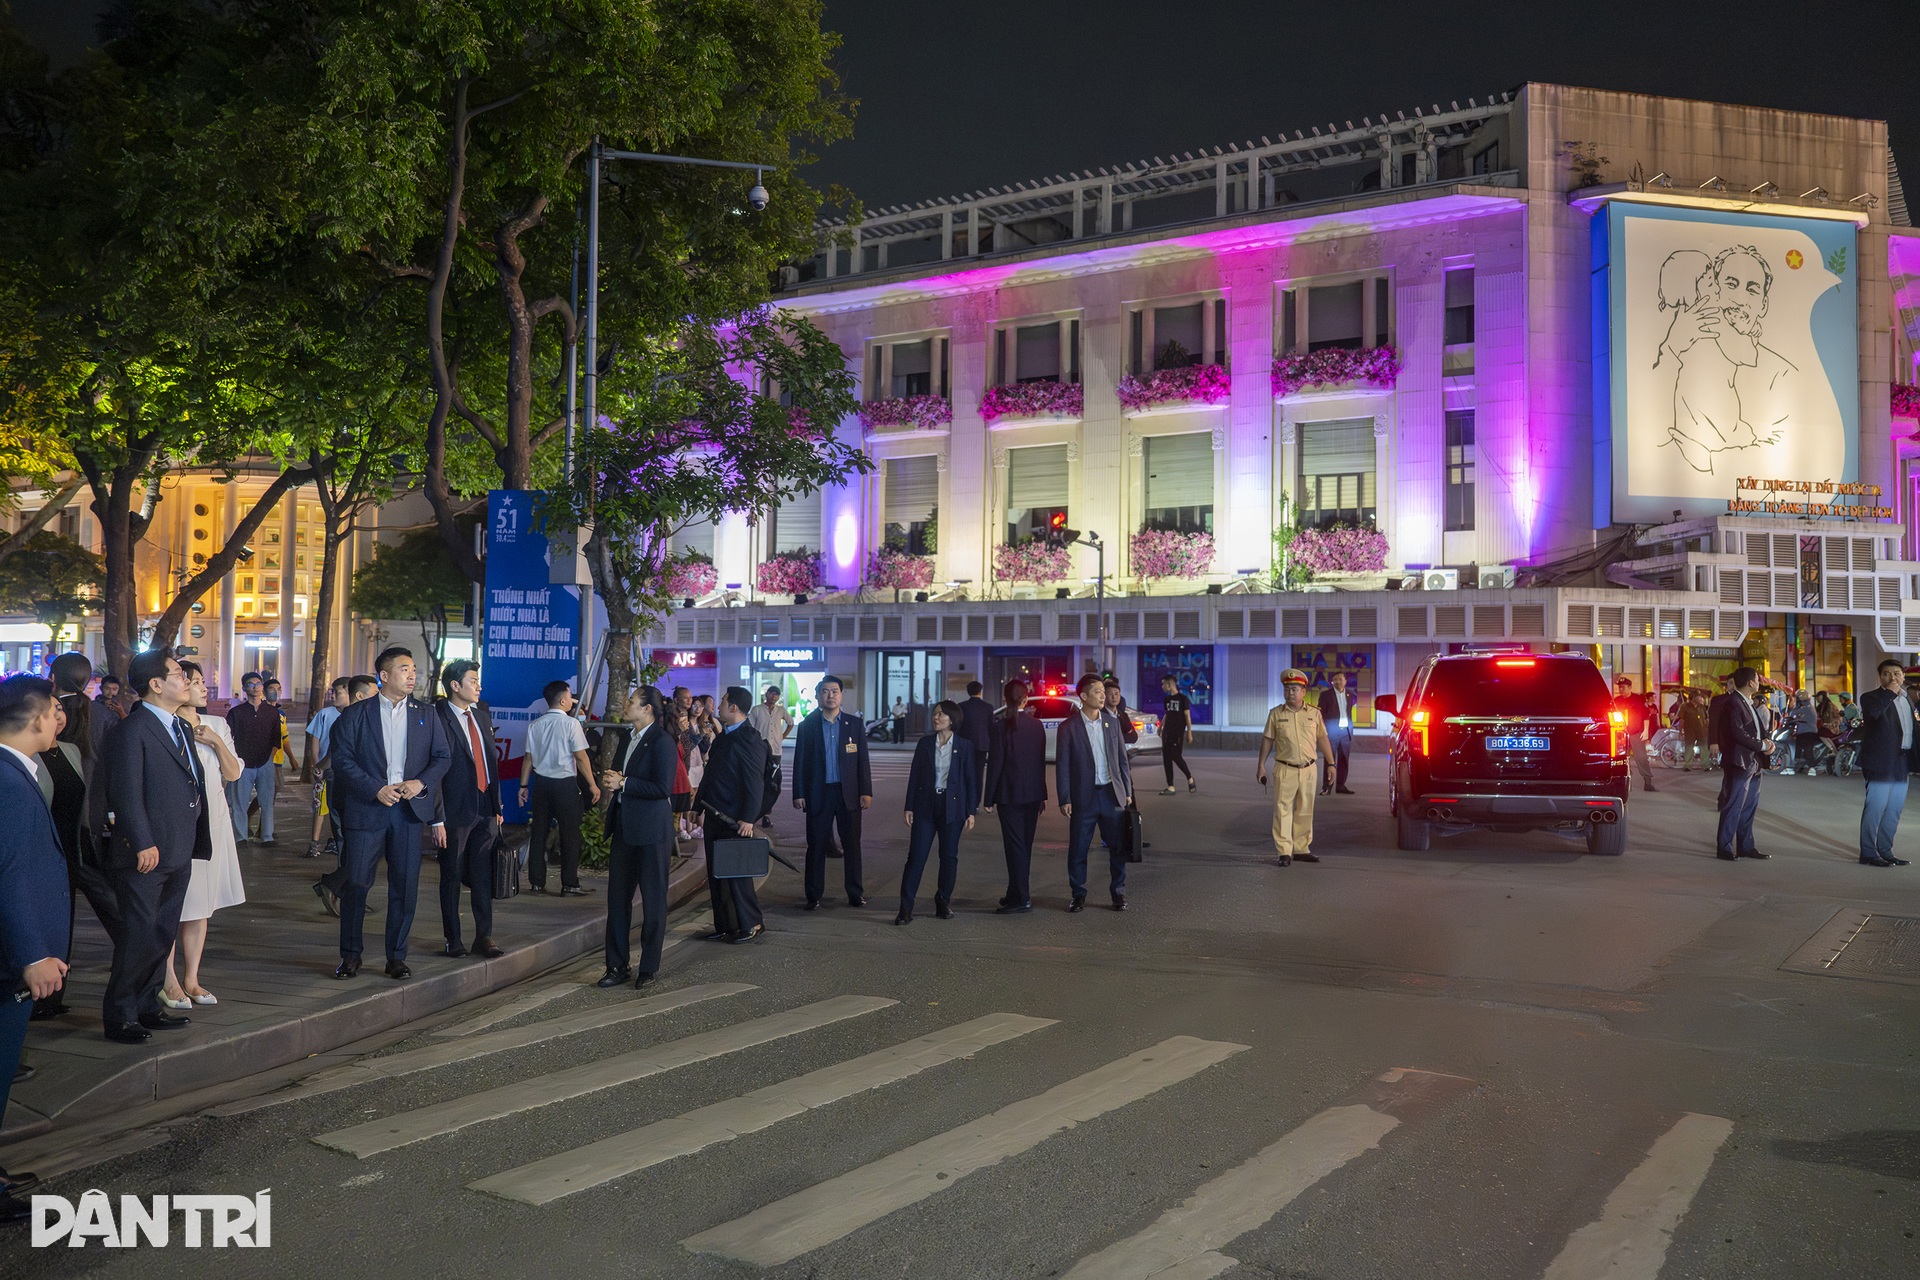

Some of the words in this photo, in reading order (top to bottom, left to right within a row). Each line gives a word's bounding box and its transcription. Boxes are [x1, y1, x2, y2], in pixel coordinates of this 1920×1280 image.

[496, 508, 518, 529] 51
[526, 587, 551, 605] NHẤT
[490, 605, 516, 622] NƯỚC
[517, 606, 537, 623] NHÀ
[538, 606, 550, 623] LÀ
[489, 625, 509, 640] CON
[511, 623, 542, 641] ĐƯỜNG
[544, 623, 571, 642] SỐNG
[488, 640, 506, 657] CỦA
[508, 642, 535, 658] NHÂN
[558, 645, 570, 660] TA
